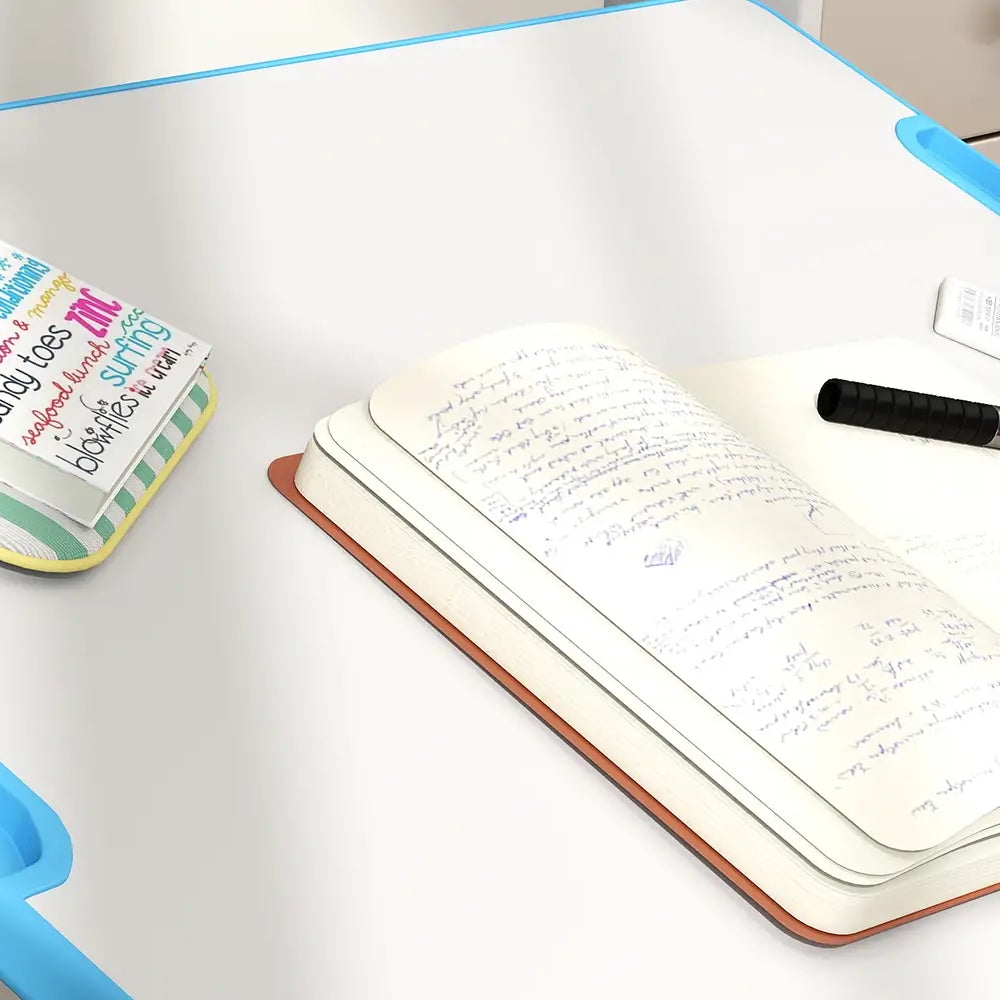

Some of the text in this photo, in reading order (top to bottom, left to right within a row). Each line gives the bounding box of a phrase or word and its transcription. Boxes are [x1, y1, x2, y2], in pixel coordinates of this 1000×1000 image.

[12, 319, 30, 331] &
[17, 324, 73, 368] toes
[99, 318, 172, 388] surfing
[21, 340, 111, 447] seafood lunch
[55, 394, 141, 476] blowflies
